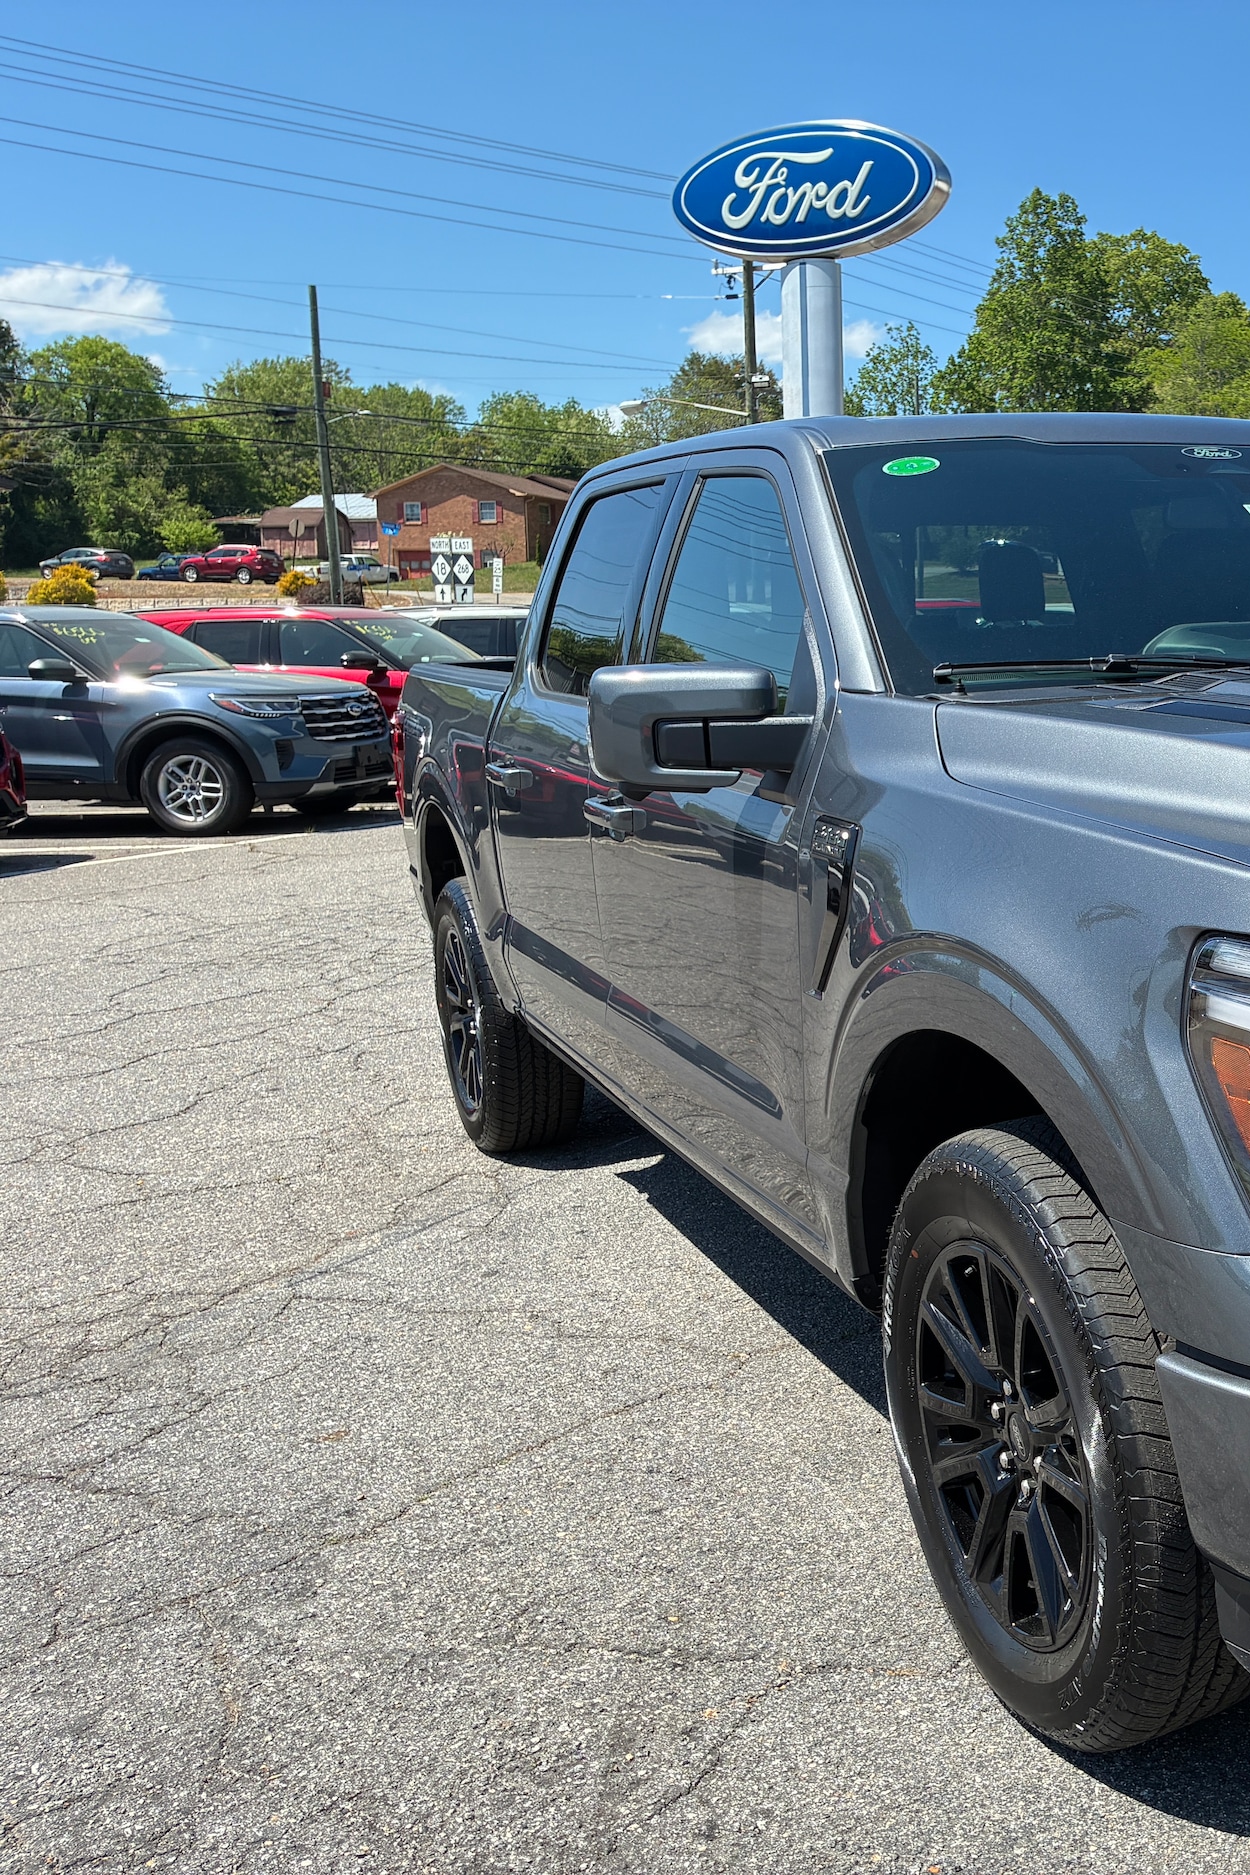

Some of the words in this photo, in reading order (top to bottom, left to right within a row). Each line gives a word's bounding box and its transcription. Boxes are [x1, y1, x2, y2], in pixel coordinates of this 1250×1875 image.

[721, 147, 874, 229] Ford
[1193, 447, 1232, 457] Ford
[431, 541, 449, 549] NORTH
[454, 541, 470, 549] EAST
[436, 562, 446, 576] 18
[457, 565, 470, 574] 268
